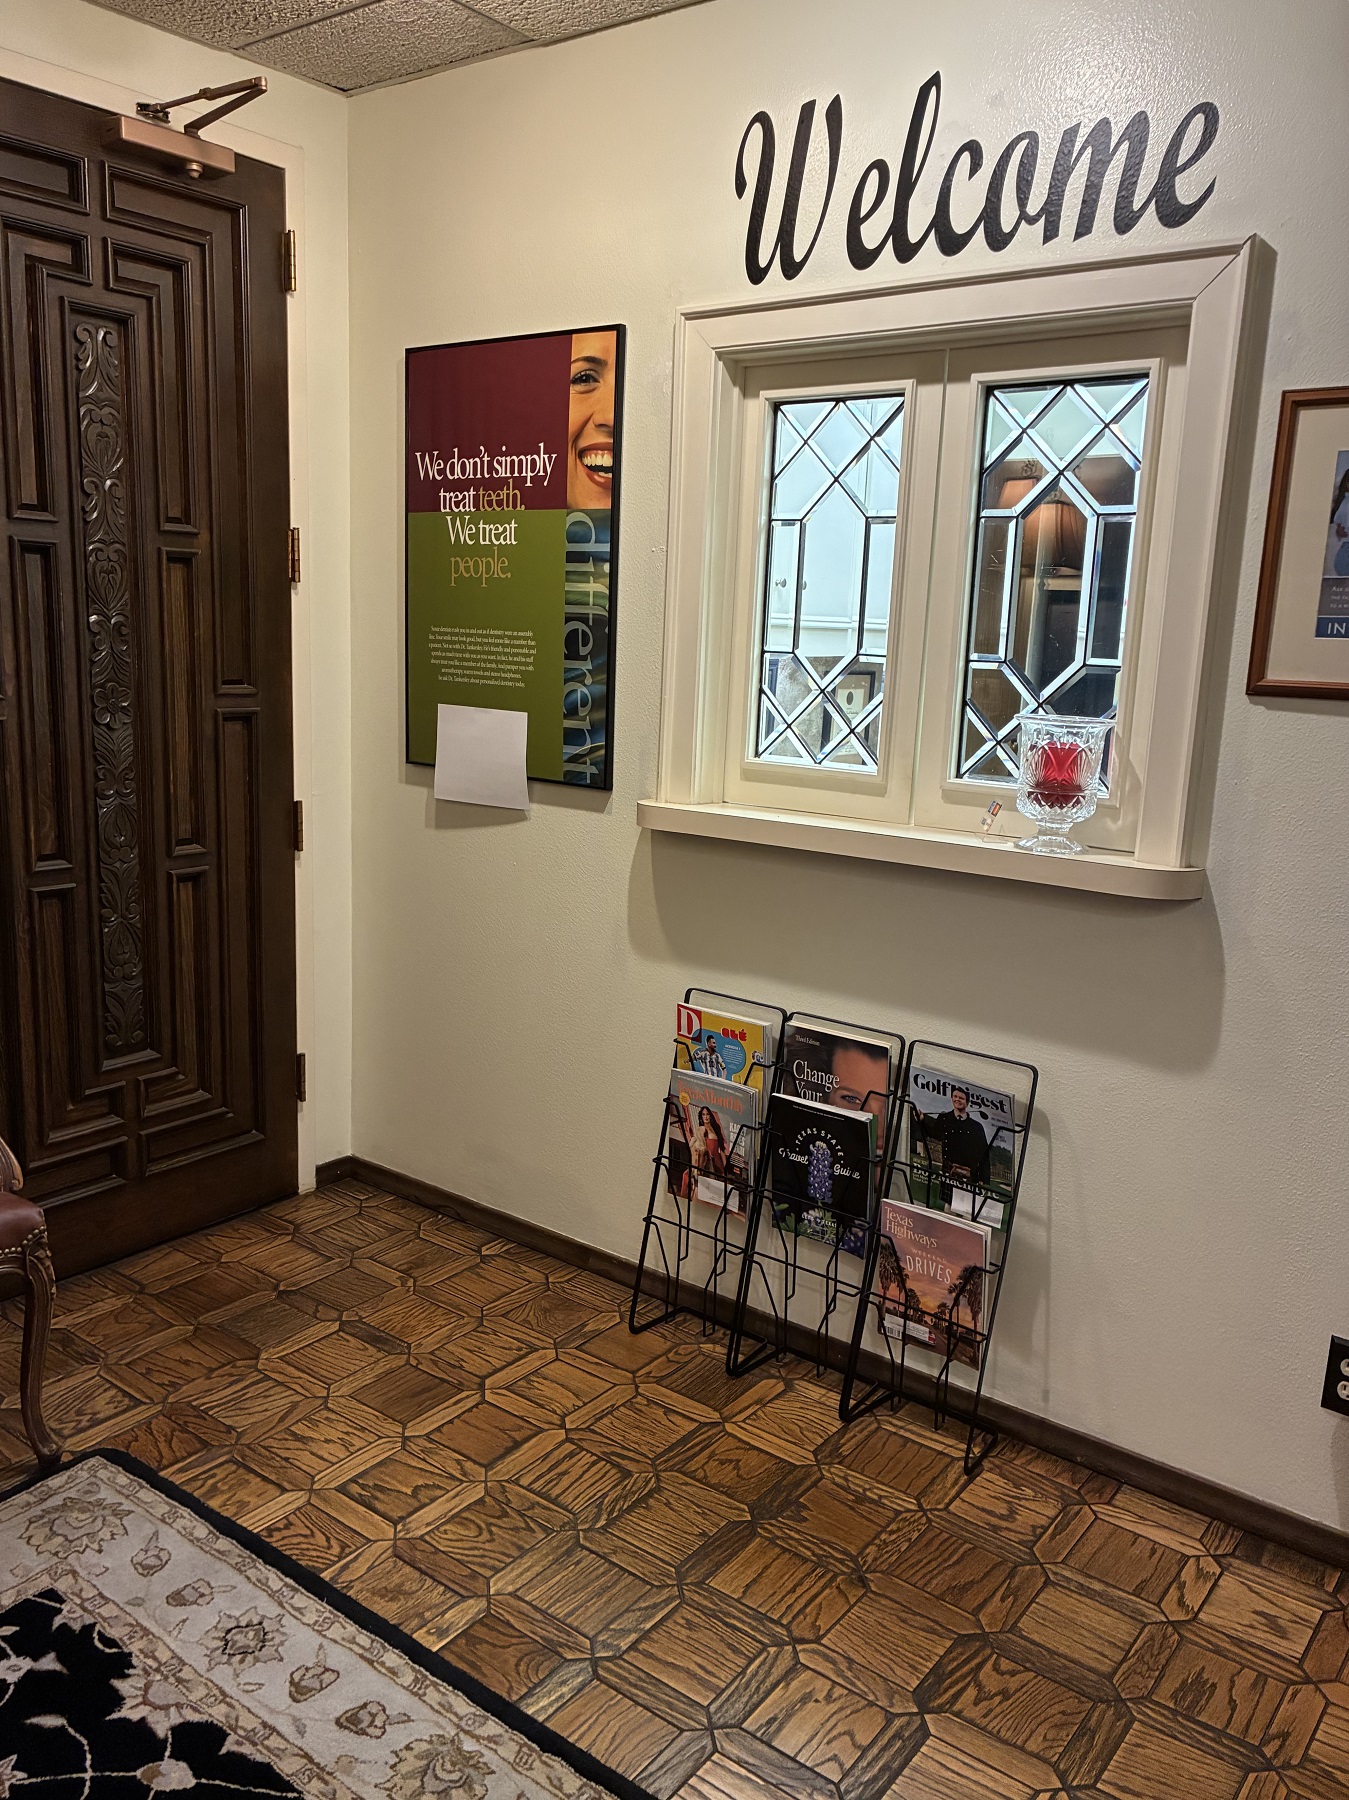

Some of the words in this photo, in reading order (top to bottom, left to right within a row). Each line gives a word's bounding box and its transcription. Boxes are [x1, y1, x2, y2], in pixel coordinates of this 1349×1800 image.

[735, 70, 1220, 285] Welcome
[415, 450, 444, 481] We
[446, 445, 491, 480] don't
[492, 442, 557, 487] simply
[439, 486, 476, 512] treat
[478, 479, 526, 511] teeth.
[445, 515, 475, 545] We
[478, 518, 518, 545] treat
[450, 546, 511, 587] people.
[563, 511, 610, 784] different
[793, 1060, 840, 1092] Change
[796, 1080, 822, 1102] Your
[913, 1074, 951, 1096] Golf
[796, 1128, 818, 1146] TEXAS
[820, 1130, 844, 1156] STATE
[884, 1206, 914, 1228] Texas
[886, 1219, 938, 1248] Highways
[906, 1255, 952, 1285] DRIVES
[912, 1248, 948, 1264] WEEKEND
